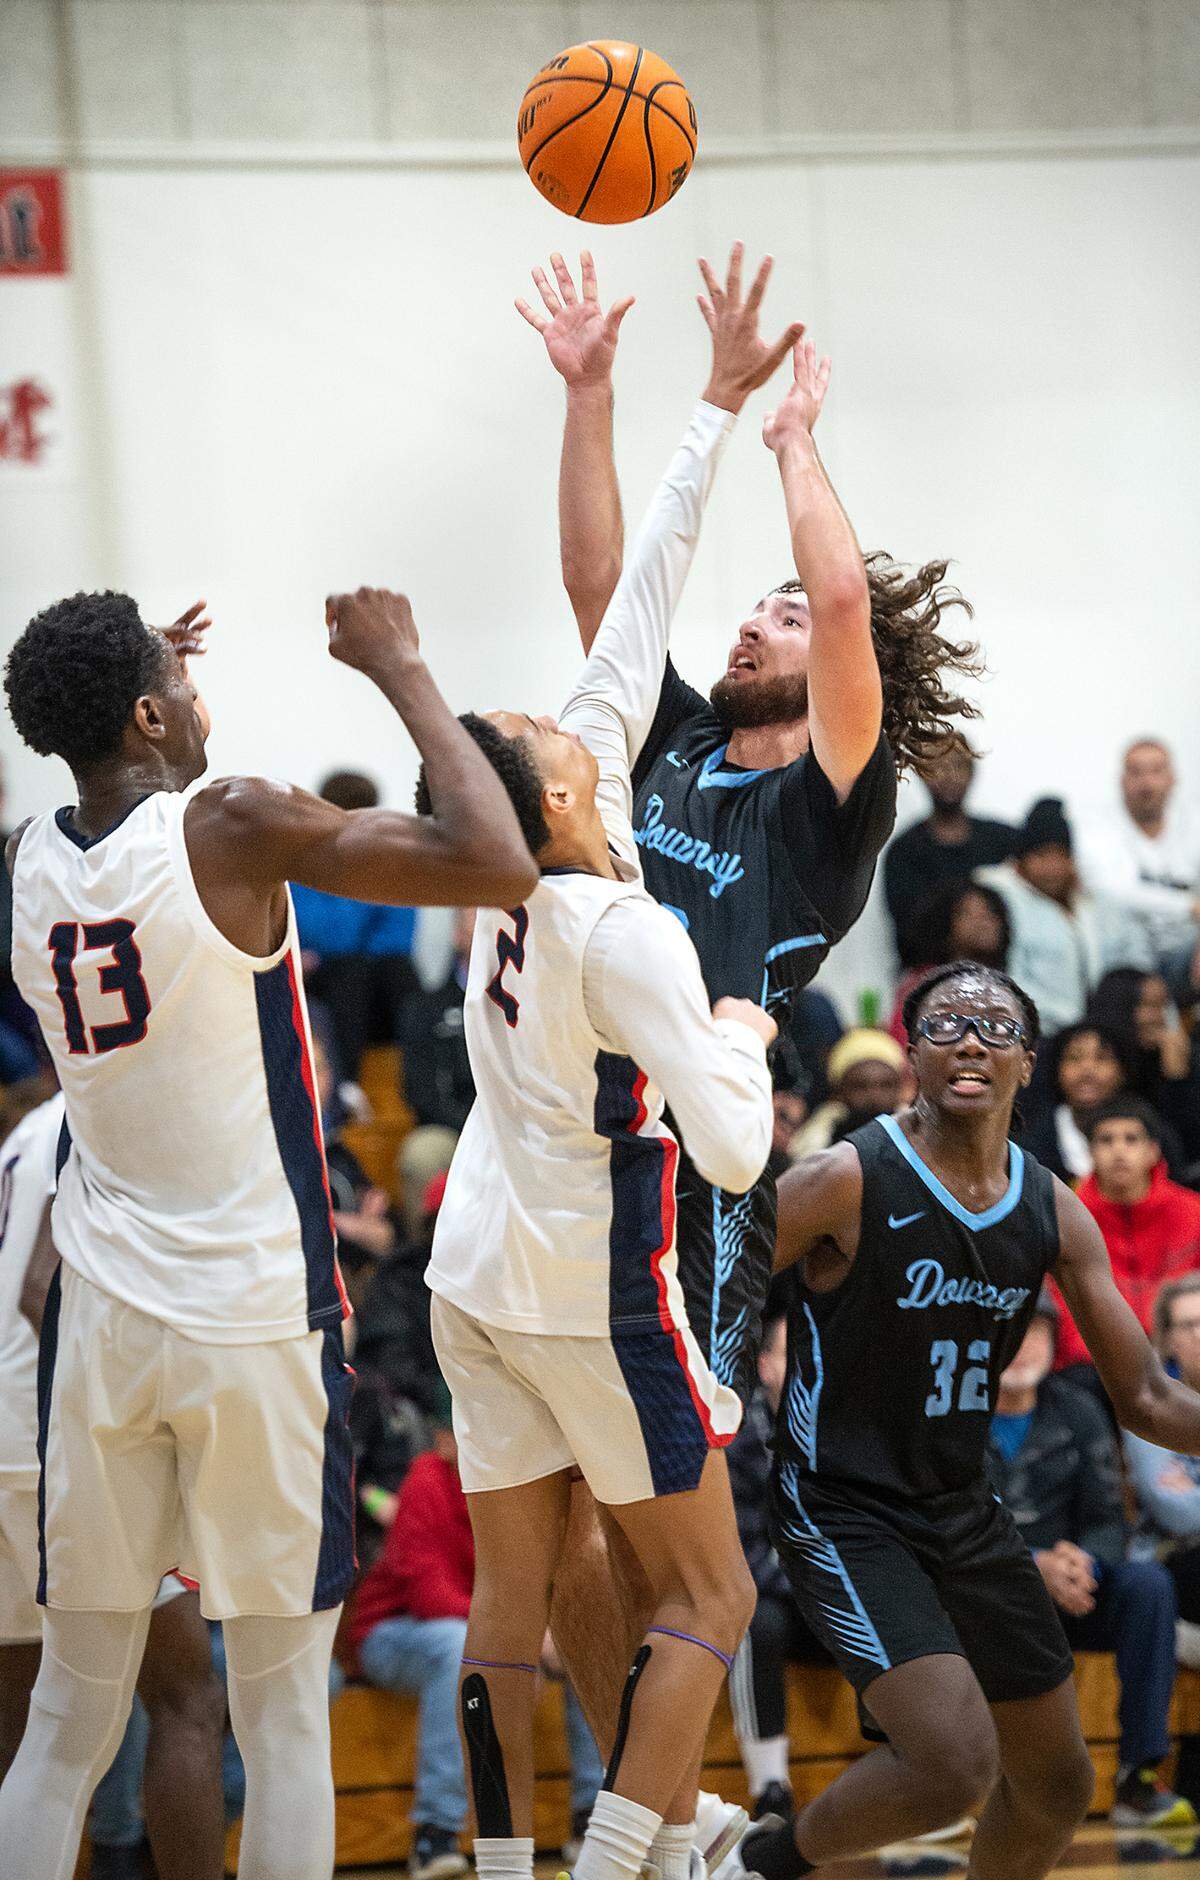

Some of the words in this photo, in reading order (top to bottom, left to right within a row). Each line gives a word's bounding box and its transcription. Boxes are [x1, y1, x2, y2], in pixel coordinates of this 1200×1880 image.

[48, 918, 151, 1054] 13
[896, 1258, 1032, 1322] Downey
[924, 1339, 991, 1418] 32
